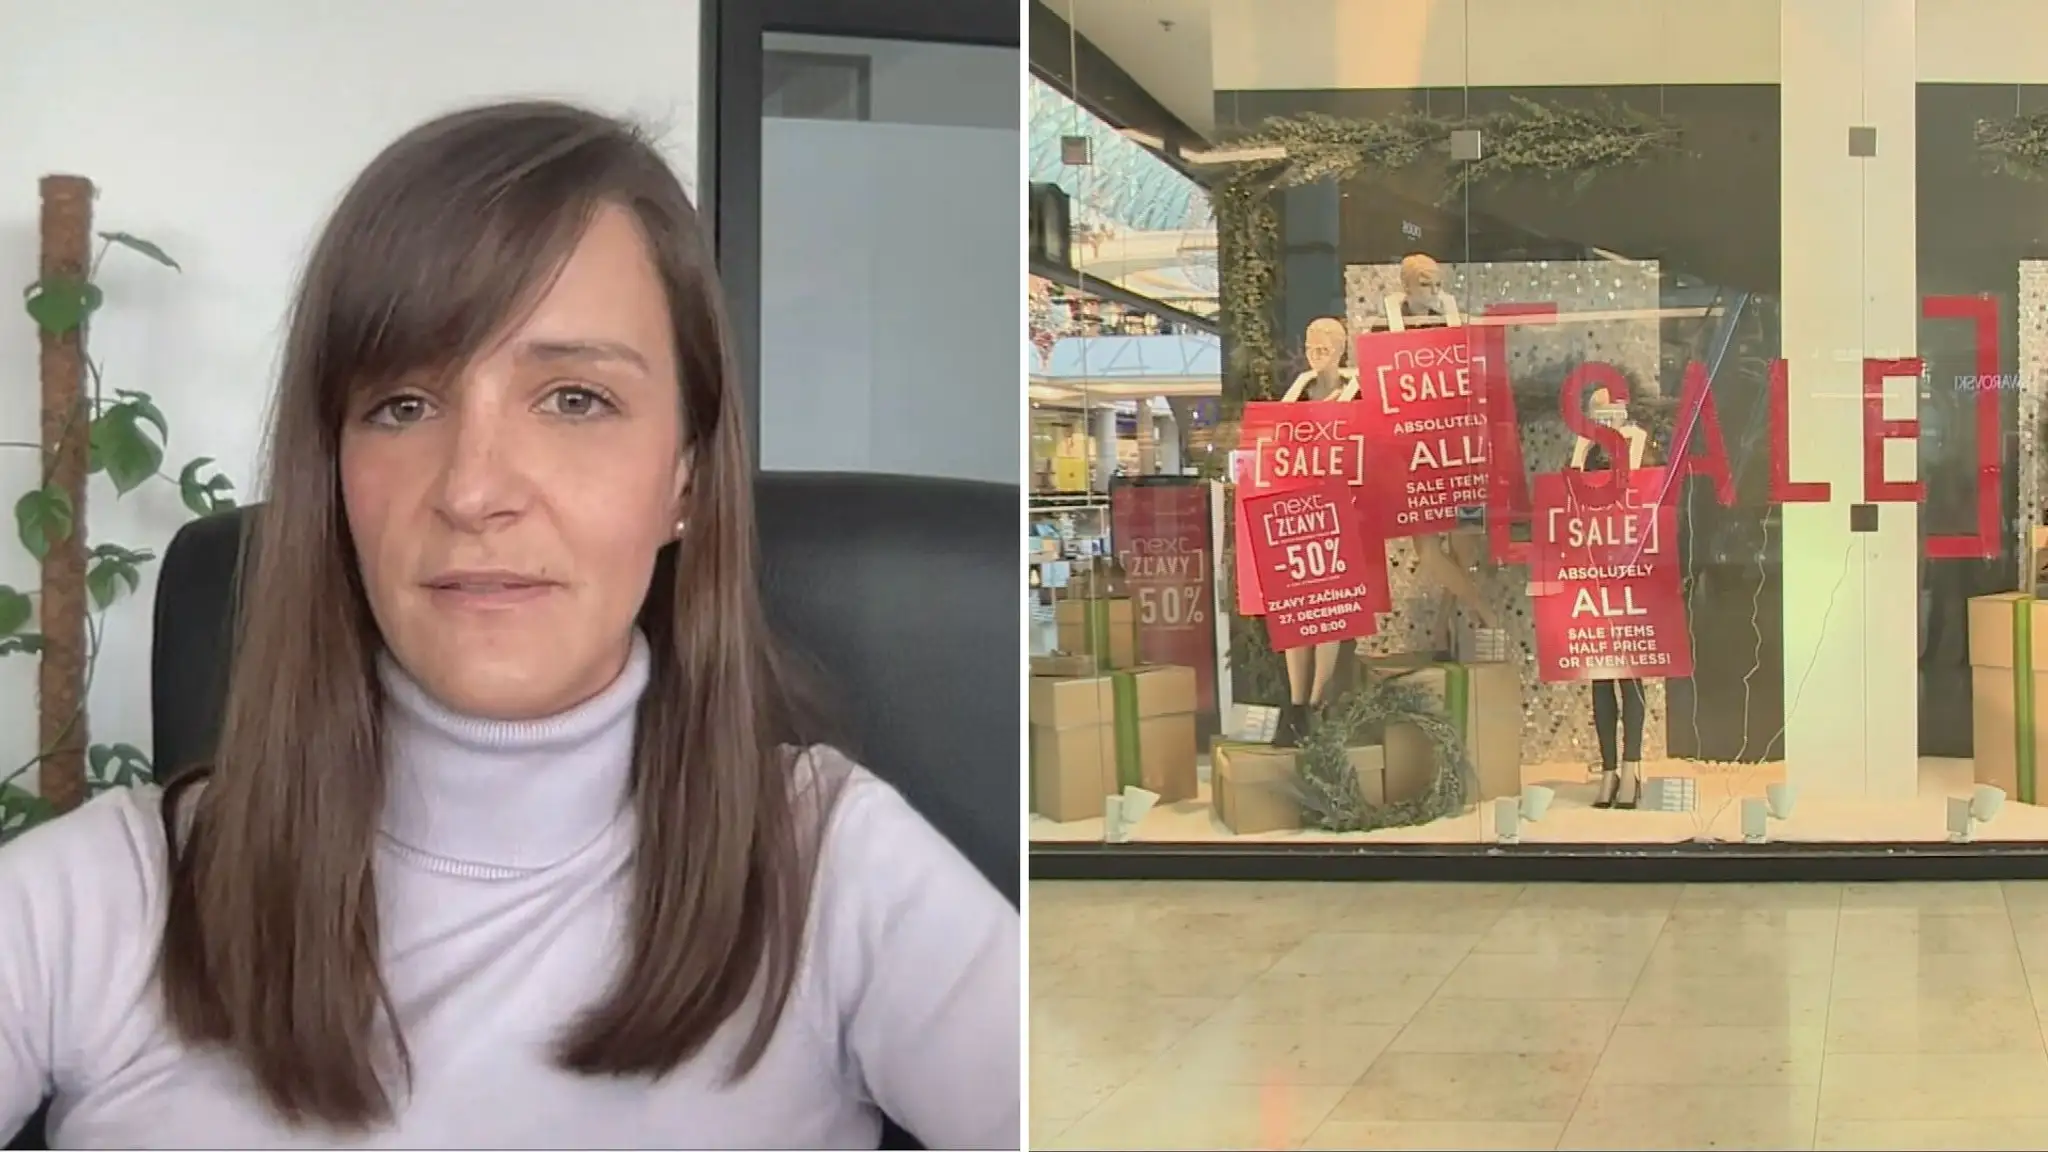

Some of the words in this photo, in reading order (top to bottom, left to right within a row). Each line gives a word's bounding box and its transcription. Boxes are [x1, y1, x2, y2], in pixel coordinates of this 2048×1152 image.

[1394, 343, 1469, 369] next
[1399, 367, 1472, 402] SALE
[1275, 420, 1347, 442] next
[1560, 357, 1927, 505] SALE
[1274, 445, 1344, 476] SALE
[1409, 435, 1487, 471] ALL
[1406, 477, 1444, 494] SALE
[1272, 494, 1324, 517] next
[1407, 494, 1447, 509] HALF
[1453, 488, 1487, 503] PRIC
[1397, 510, 1419, 524] OR
[1568, 515, 1639, 547] SALE
[1131, 536, 1191, 555] next
[1274, 537, 1347, 580] -50%
[1558, 564, 1654, 580] ABSOLUTELY
[1139, 584, 1204, 624] 50%
[1297, 601, 1362, 622] DECEMBRA
[1571, 585, 1647, 618] ALL
[1300, 624, 1318, 636] OD
[1568, 627, 1606, 640] SALE
[1611, 625, 1655, 638] ITEMS
[1569, 641, 1607, 654] HALF
[1613, 640, 1657, 652] PRICE
[1559, 656, 1580, 669] OR
[1586, 654, 1625, 668] EVEN
[1631, 653, 1671, 666] LESS!
